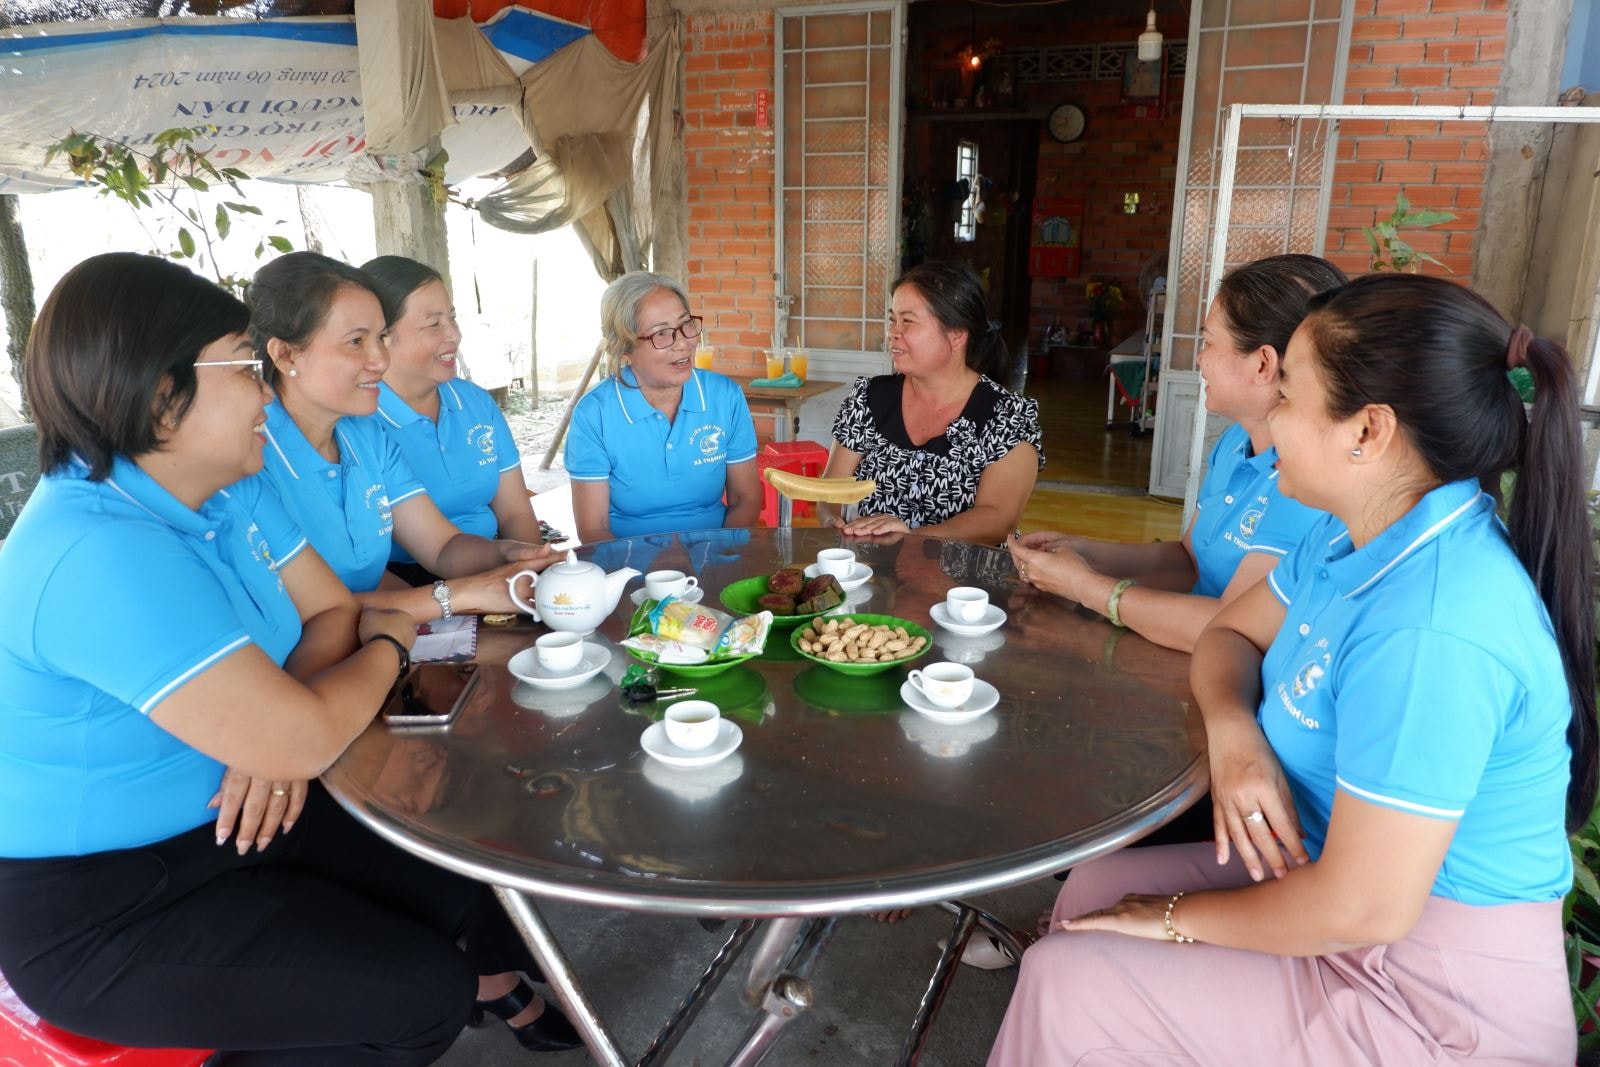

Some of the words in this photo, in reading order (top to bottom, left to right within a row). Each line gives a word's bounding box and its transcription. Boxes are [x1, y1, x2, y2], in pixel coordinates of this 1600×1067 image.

[132, 71, 190, 90] 2024
[195, 71, 241, 86] năm
[246, 71, 271, 84] 06
[278, 67, 328, 86] tháng
[172, 100, 250, 119] DÂN
[254, 120, 322, 136] TRỢ
